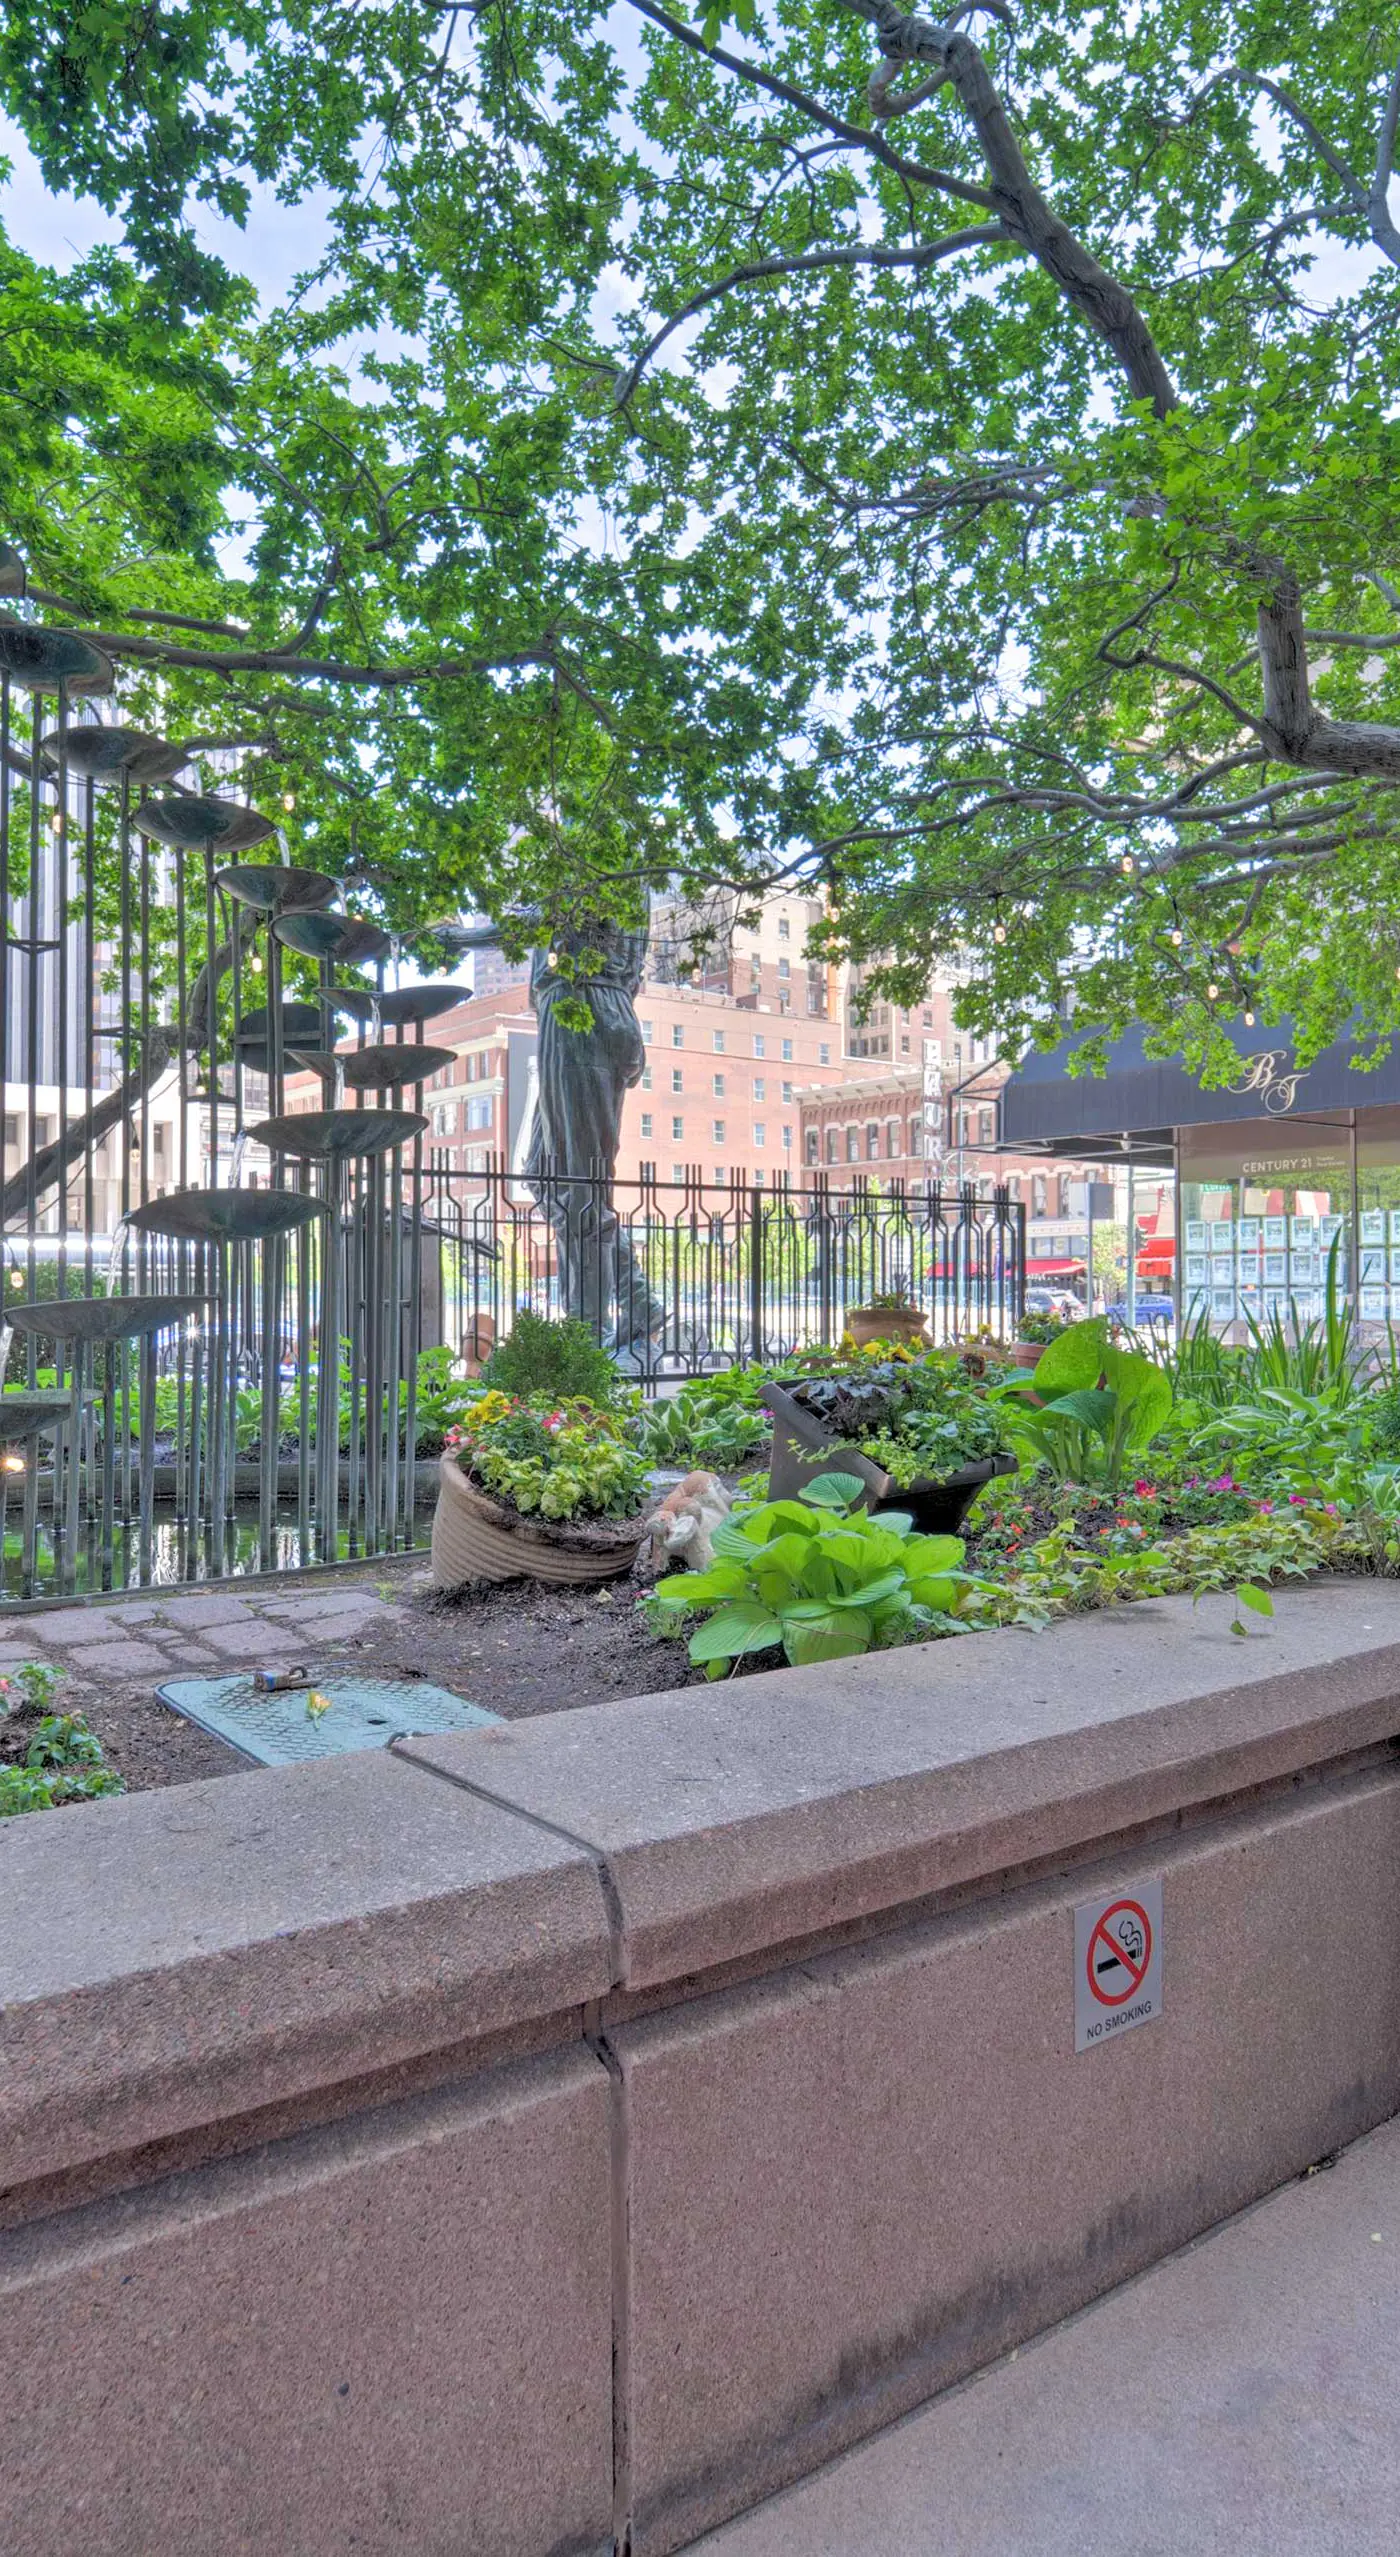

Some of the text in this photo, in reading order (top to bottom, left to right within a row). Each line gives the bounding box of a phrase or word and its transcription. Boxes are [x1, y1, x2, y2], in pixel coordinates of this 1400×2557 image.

[1242, 1159, 1298, 1173] CENTURY
[1301, 1157, 1312, 1168] 21
[1086, 2000, 1152, 2040] NO SMOKING
